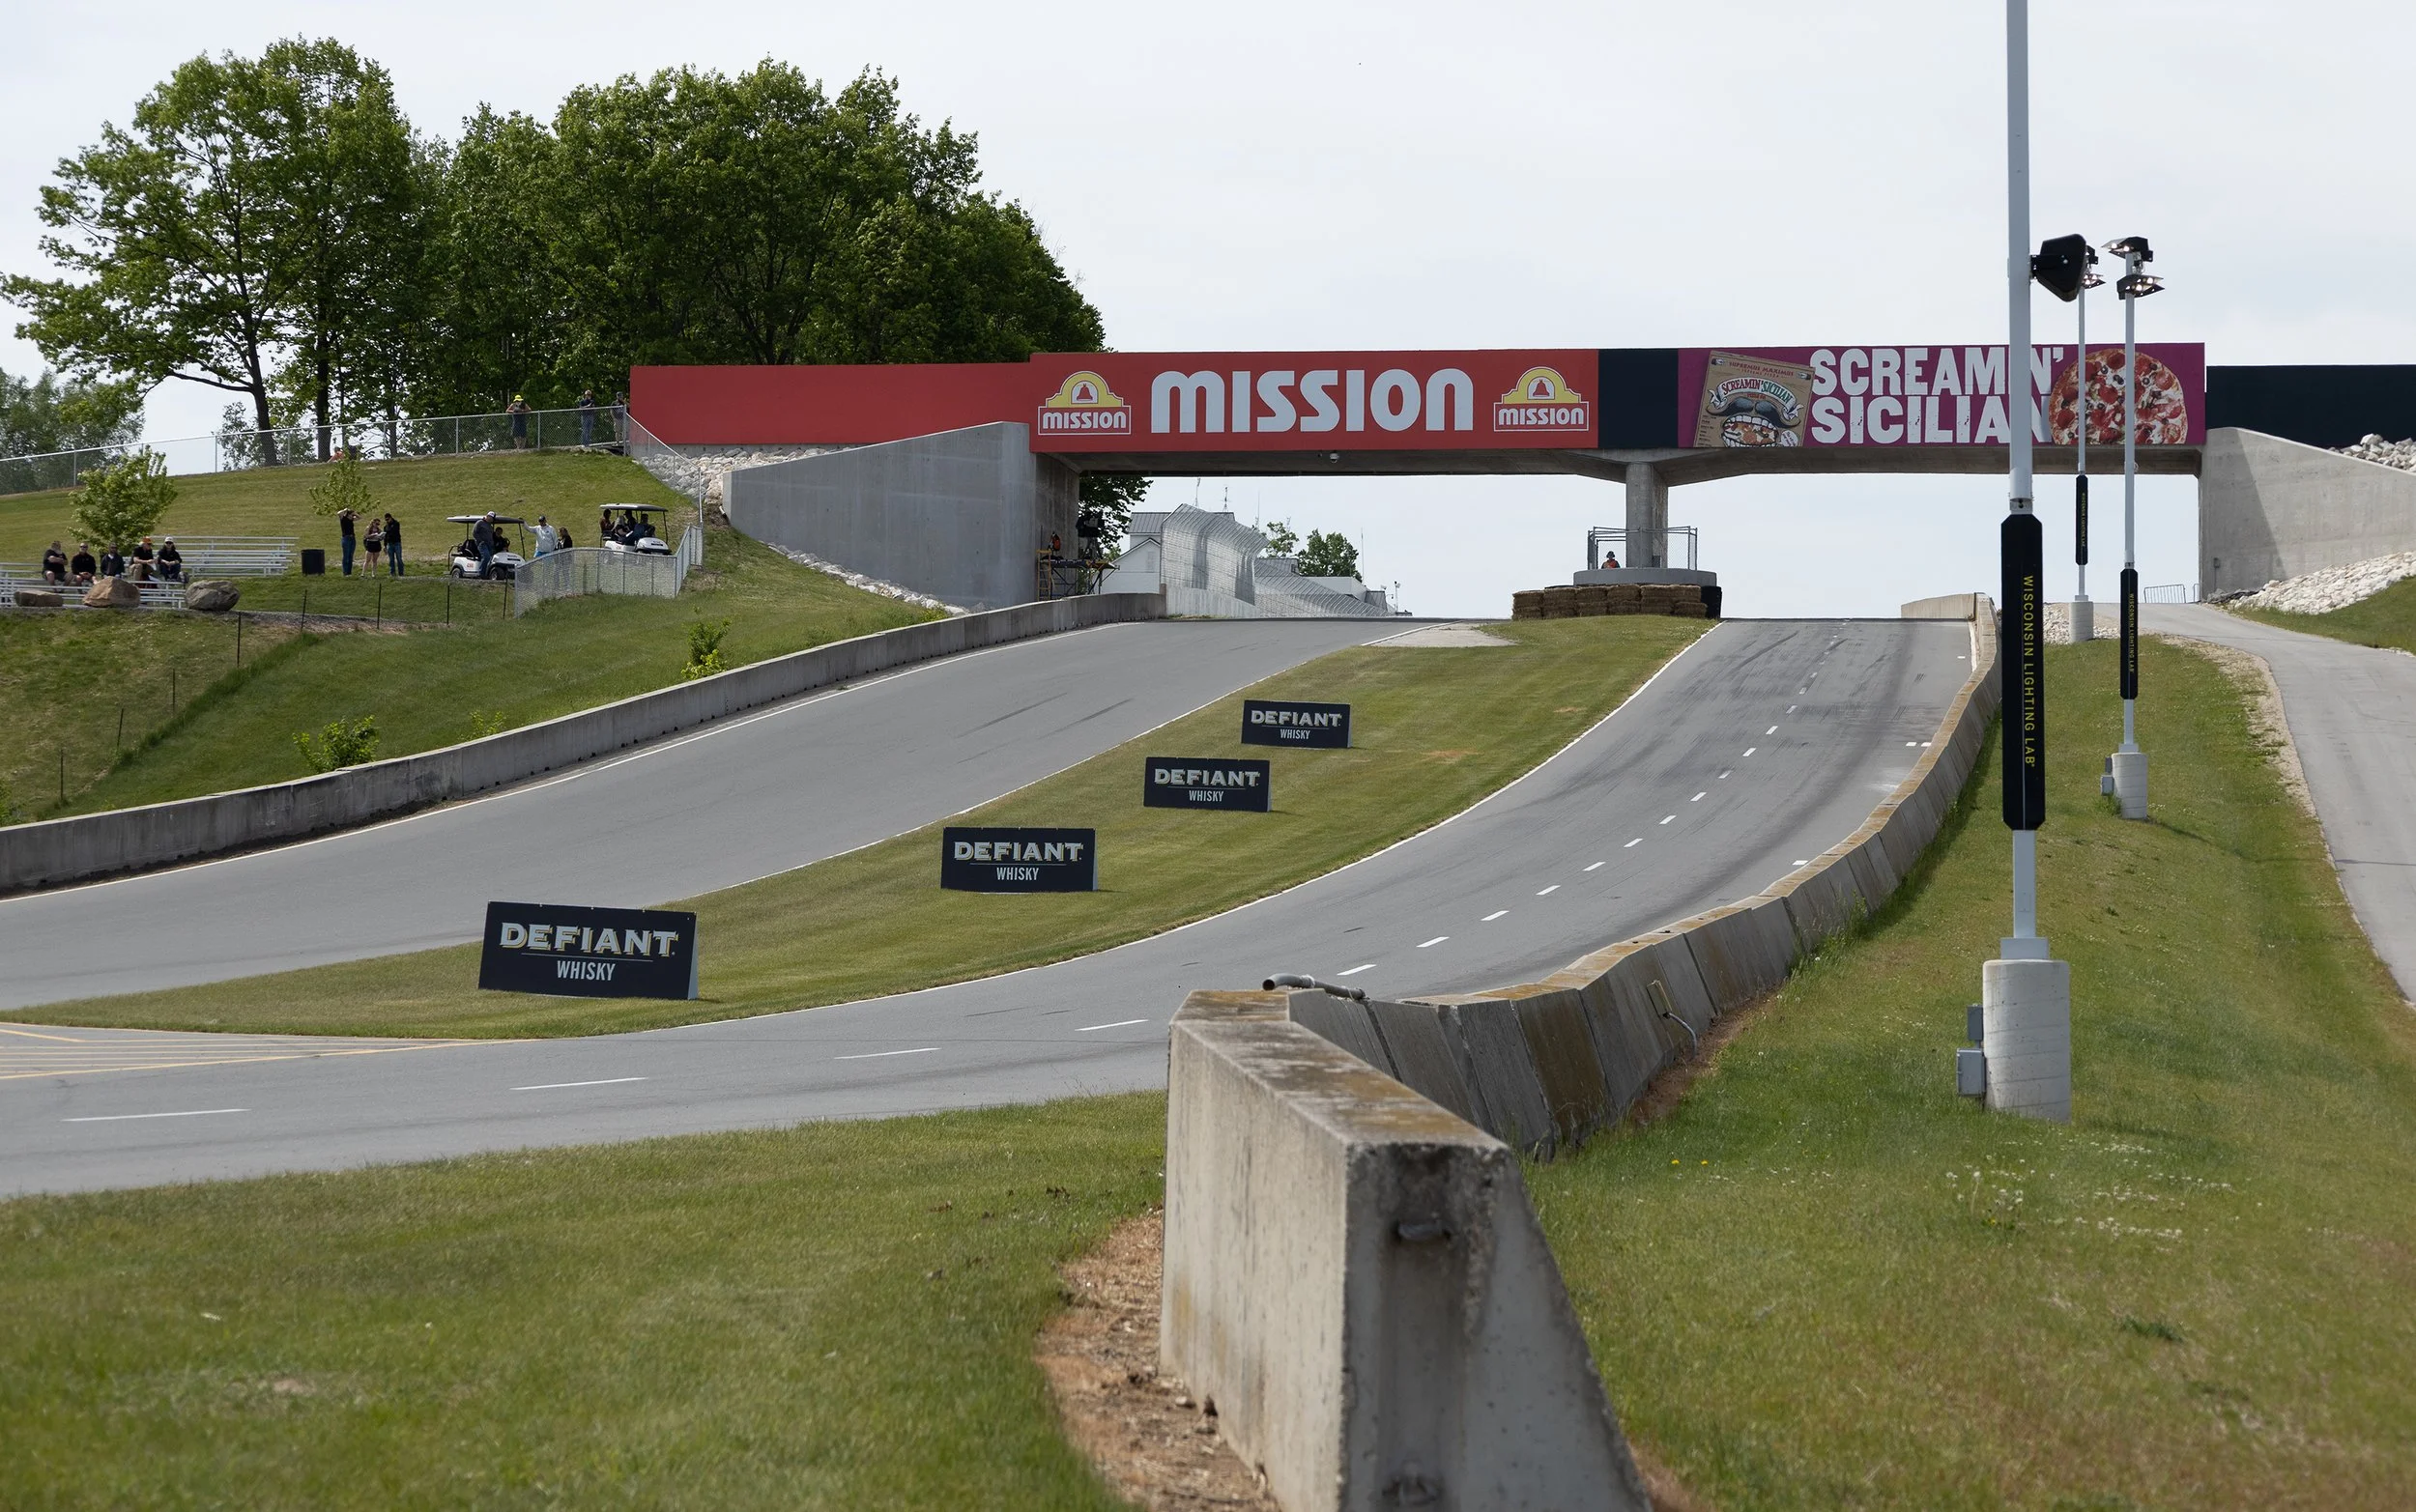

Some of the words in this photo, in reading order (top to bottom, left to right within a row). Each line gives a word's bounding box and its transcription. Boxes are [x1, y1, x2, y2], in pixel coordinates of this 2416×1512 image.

[1810, 347, 2063, 395] SCREAMN'
[1151, 368, 1474, 434] MISSION
[1043, 411, 1126, 429] MISSION
[1498, 408, 1584, 426] MISSION
[1811, 396, 2053, 443] SICILIAN
[2024, 575, 2034, 657] WISCONSIN
[2024, 663, 2035, 731] LIGHTING
[1251, 710, 1342, 727] DEFIANT
[1280, 728, 1310, 740] WHISKY
[1154, 768, 1261, 787] DEFIANT
[1189, 790, 1224, 802] WHISKY
[953, 842, 1084, 862] DEFIANT
[996, 867, 1040, 881] WHISKY
[499, 922, 679, 957] DEFIANT
[557, 960, 616, 981] WHISKY
